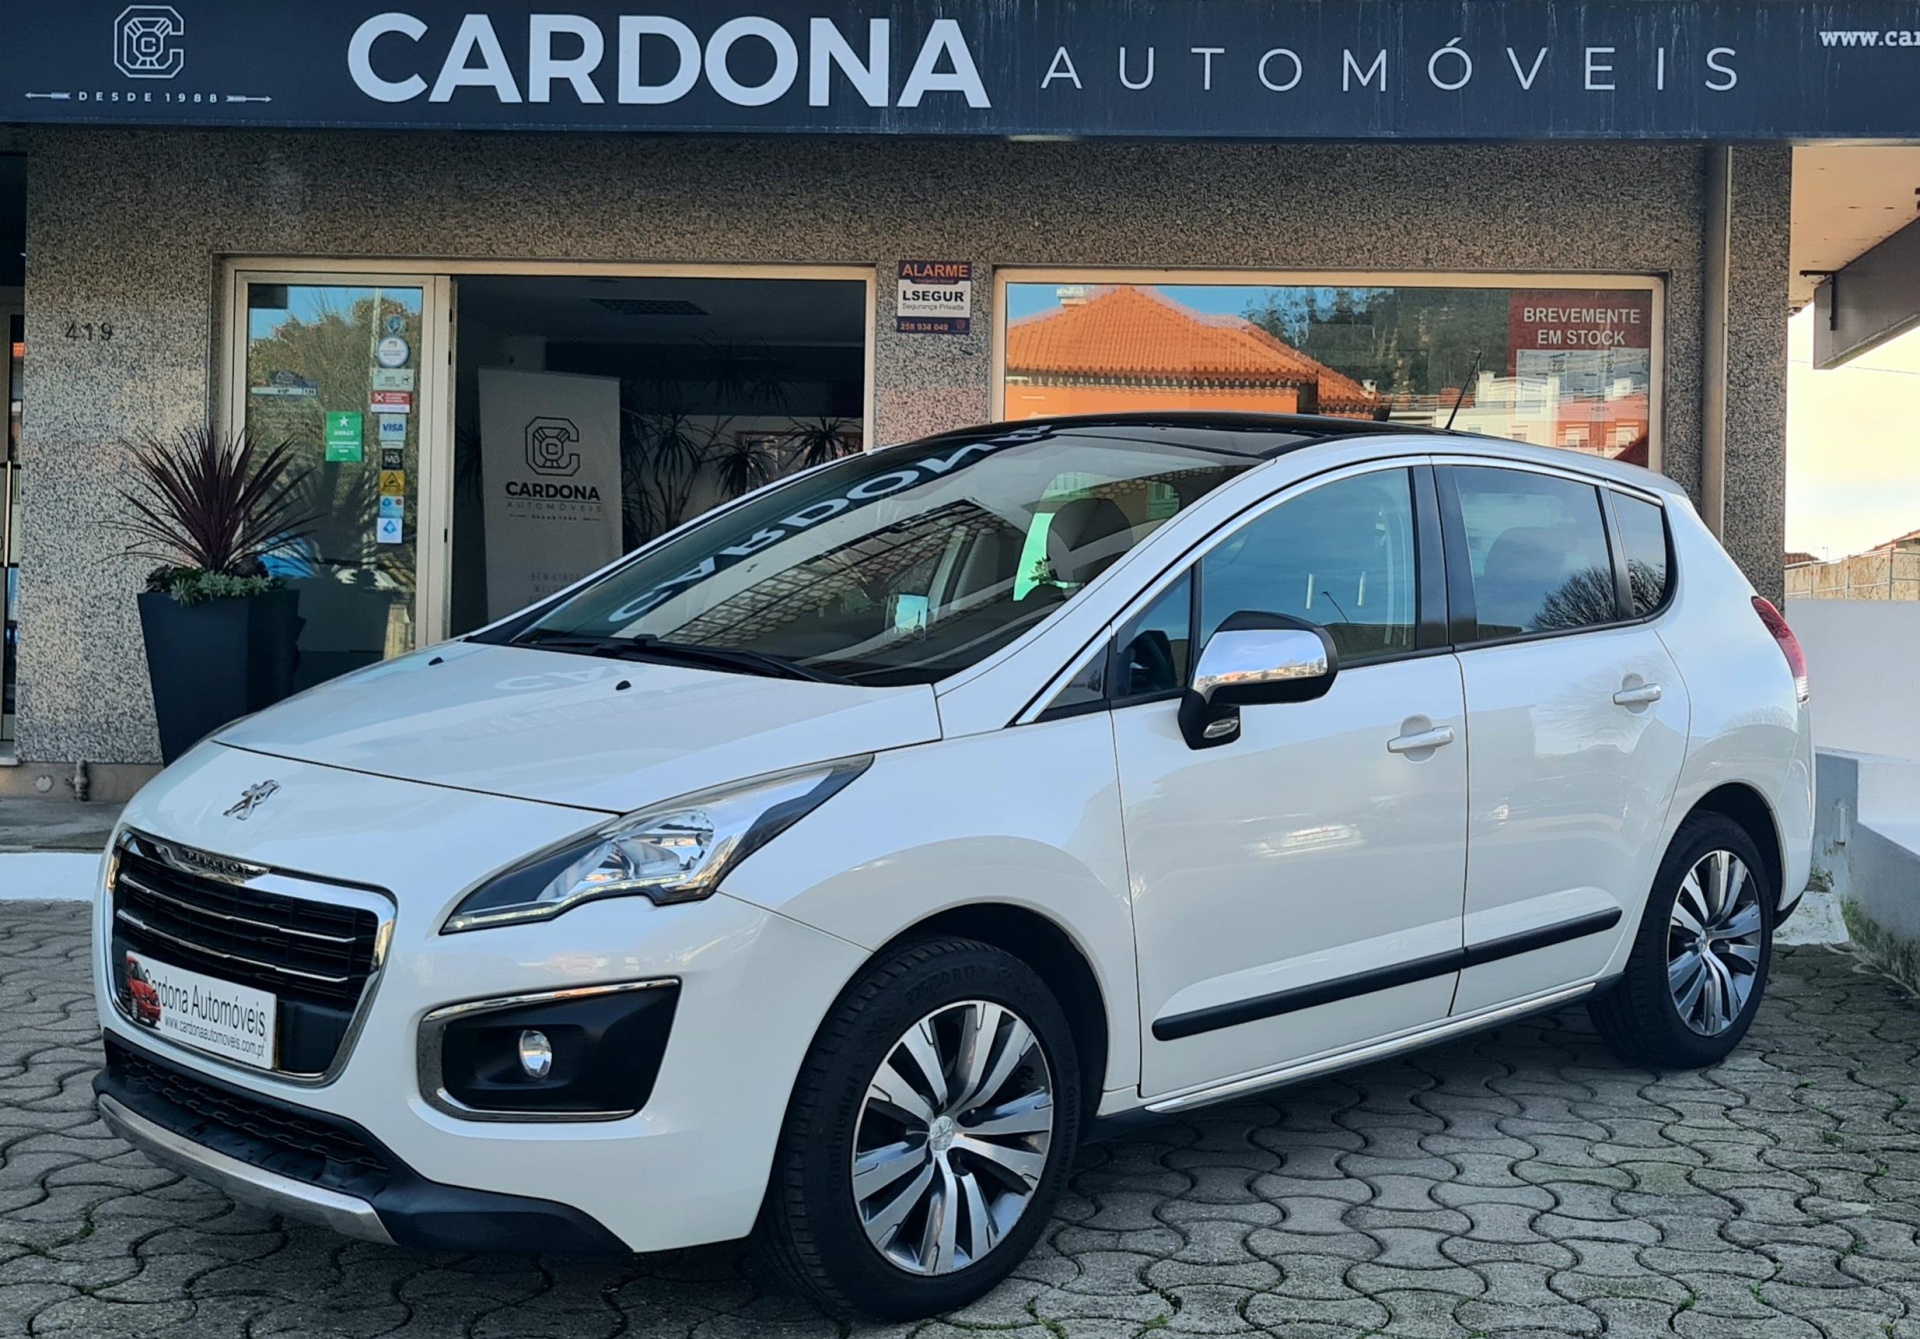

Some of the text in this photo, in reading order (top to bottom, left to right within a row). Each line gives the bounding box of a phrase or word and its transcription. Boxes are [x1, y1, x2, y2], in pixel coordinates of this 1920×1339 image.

[347, 12, 1738, 108] CARDONA AUTOMÓVEIS
[79, 91, 217, 103] DESDE 1988
[902, 264, 968, 277] ALARME
[903, 290, 964, 302] LSEGUR
[902, 303, 937, 311] Segurança
[1524, 308, 1640, 323] BREVEMENTE
[65, 322, 113, 341] 419
[1538, 330, 1625, 345] EM STOCK
[382, 423, 403, 431] VISA
[506, 481, 600, 500] CARDONA
[191, 984, 266, 1037] Automóveis
